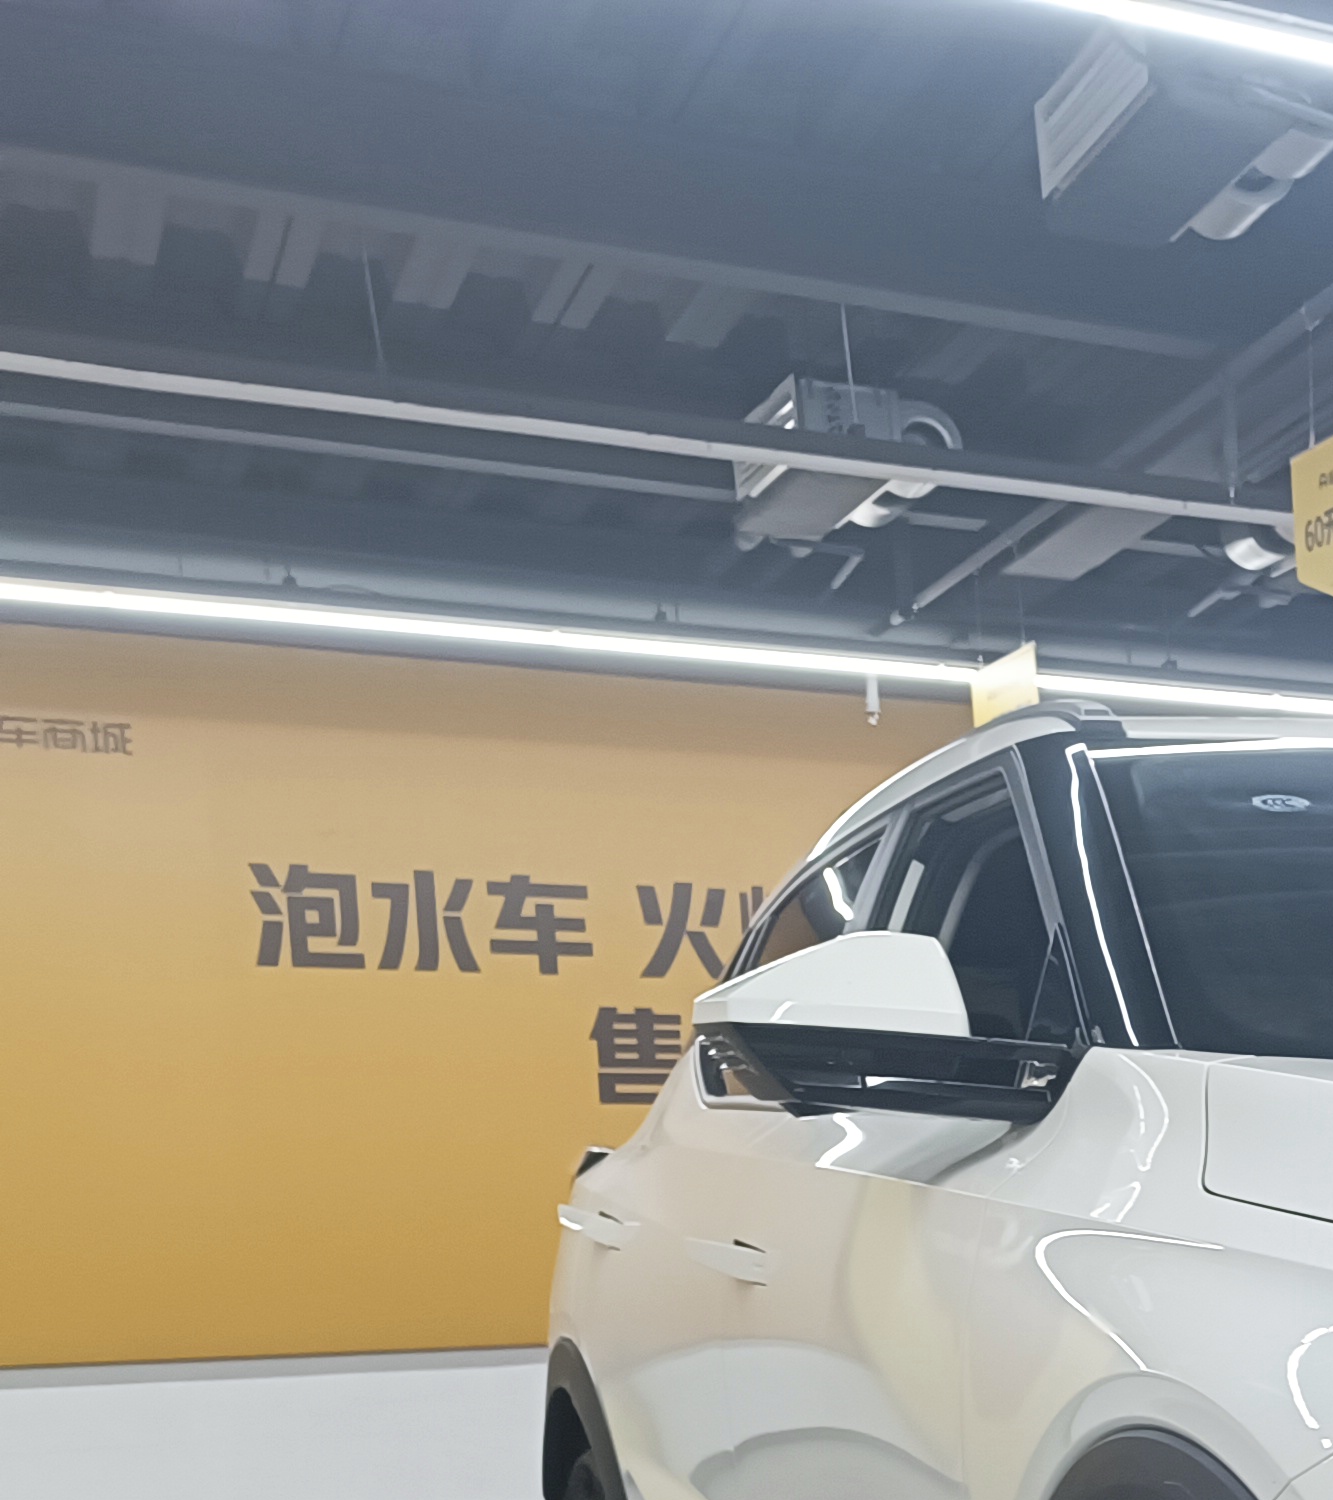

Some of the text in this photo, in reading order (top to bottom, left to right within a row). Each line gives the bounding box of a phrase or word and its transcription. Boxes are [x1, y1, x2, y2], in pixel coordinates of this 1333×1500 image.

[248, 862, 770, 979] 泡水车 火
